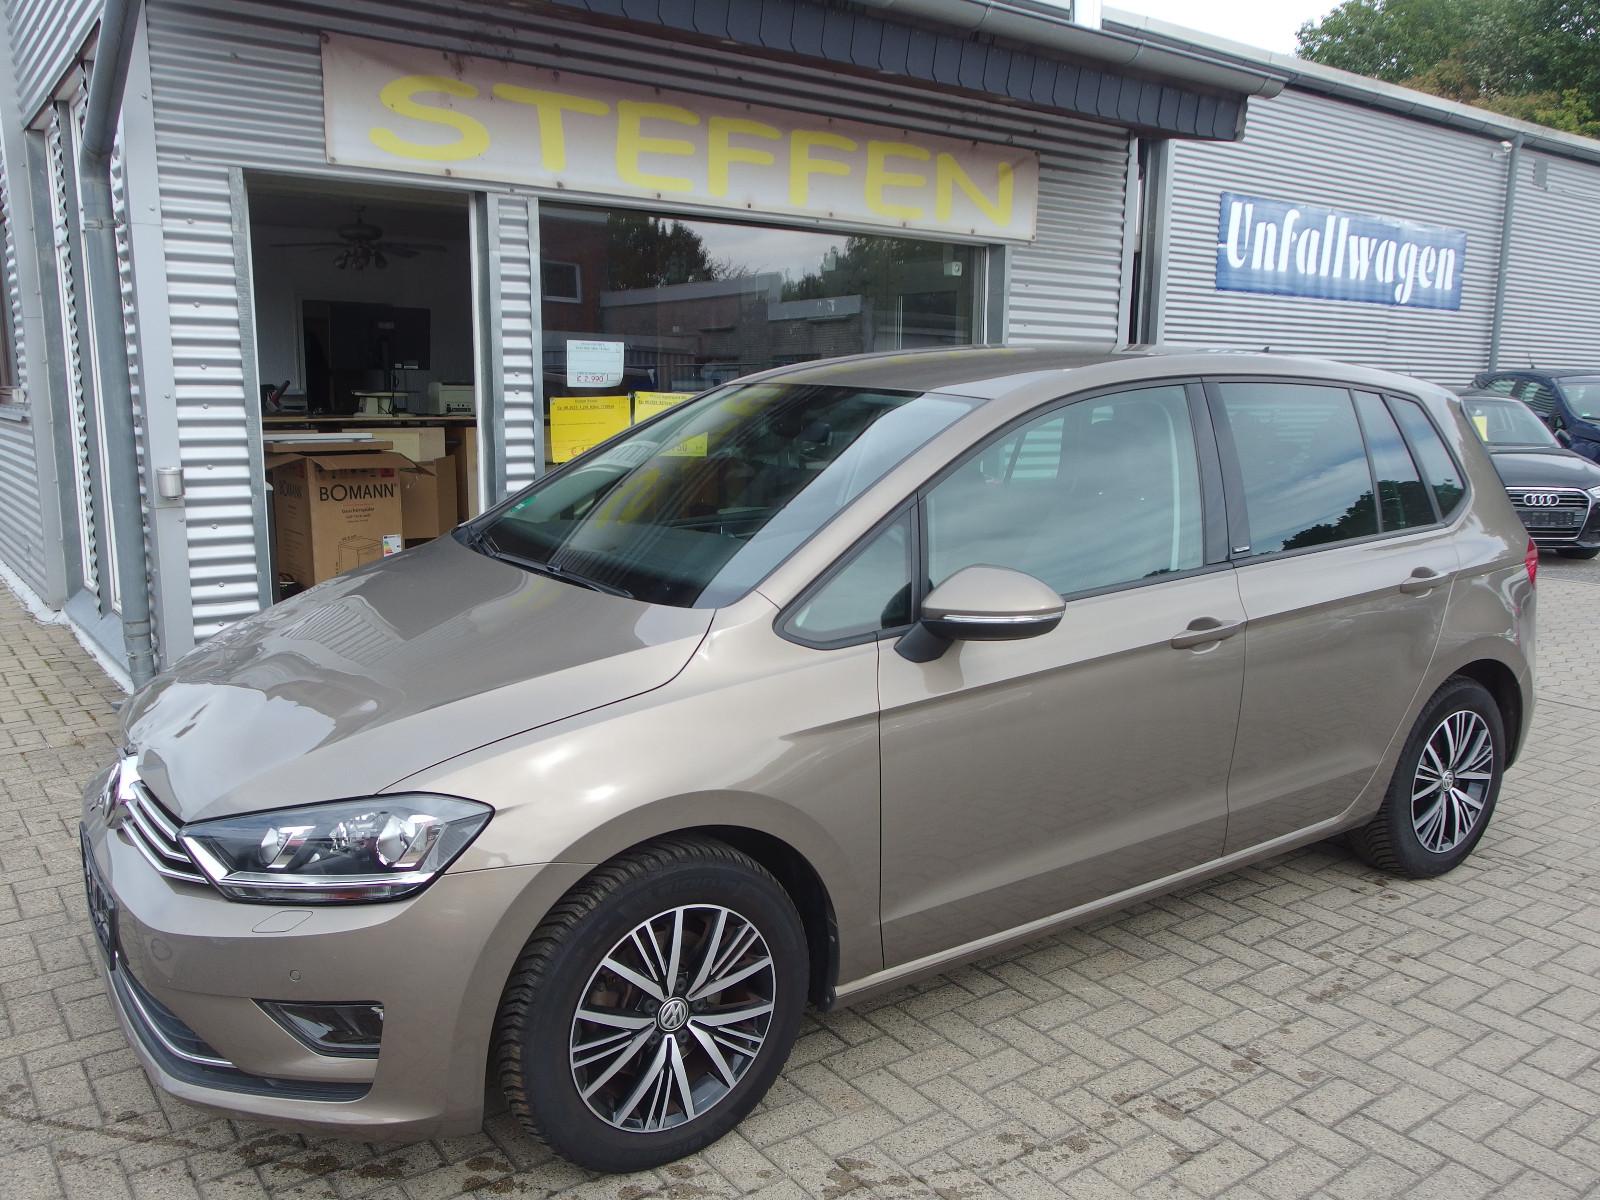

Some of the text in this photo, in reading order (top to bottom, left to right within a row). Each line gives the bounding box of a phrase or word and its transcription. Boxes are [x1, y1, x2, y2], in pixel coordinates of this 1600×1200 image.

[369, 74, 1014, 227] STEFFEN
[1226, 201, 1456, 304] Unfallwagen
[319, 483, 395, 502] BOMANN
